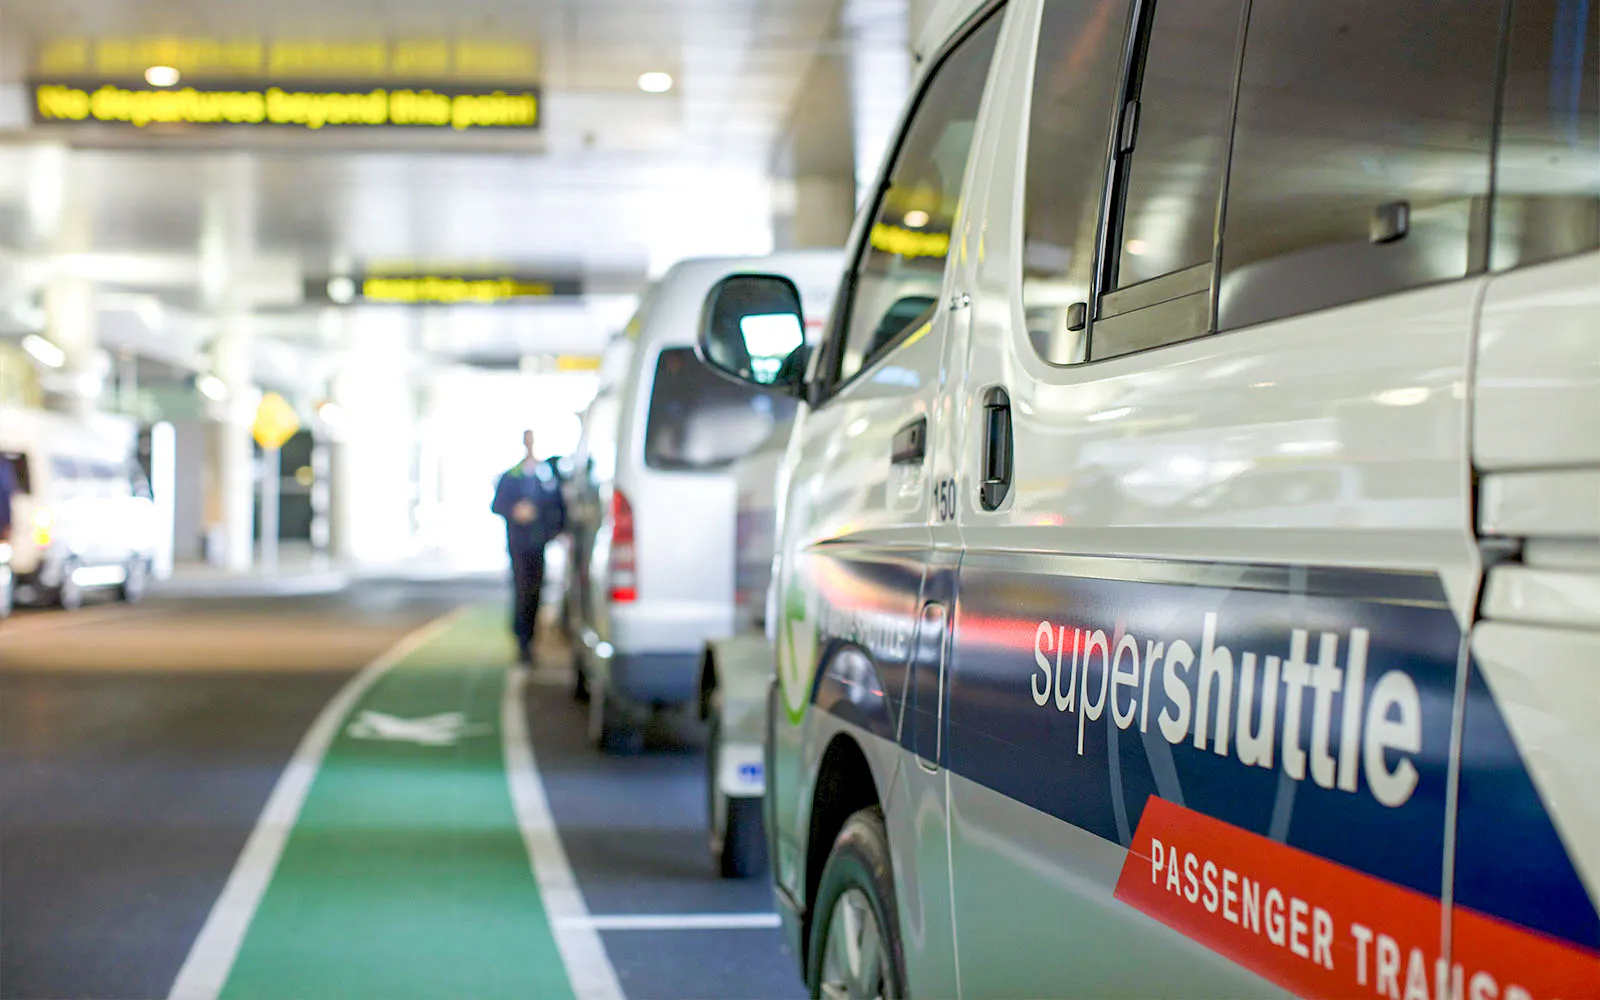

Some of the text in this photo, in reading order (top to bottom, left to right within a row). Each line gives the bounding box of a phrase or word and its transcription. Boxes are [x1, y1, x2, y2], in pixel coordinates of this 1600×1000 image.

[90, 85, 265, 126] departures
[266, 87, 388, 129] beyond
[390, 89, 450, 125] this
[451, 90, 537, 130] point
[1031, 612, 1423, 807] supershuttle
[1150, 838, 1334, 970] PASSENGER
